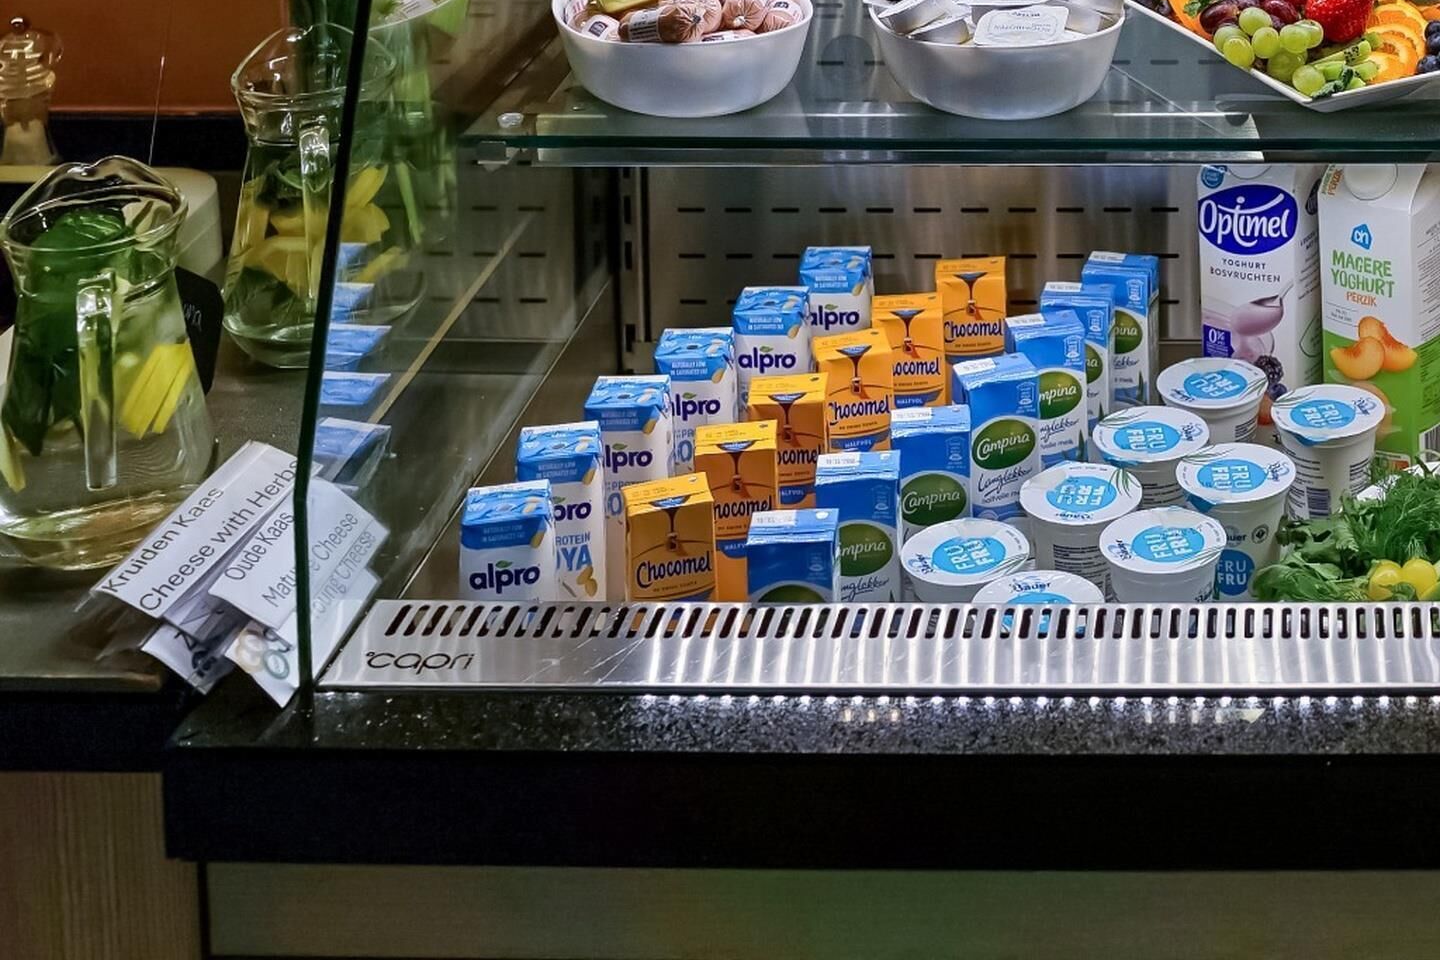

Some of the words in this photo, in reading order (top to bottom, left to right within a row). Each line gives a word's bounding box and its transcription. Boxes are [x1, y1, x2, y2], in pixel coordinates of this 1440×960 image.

[1200, 193, 1290, 248] Optimel
[1210, 266, 1281, 283] BOSVRUCHTEN
[1222, 258, 1267, 271] YOGHURT
[1332, 249, 1392, 278] MAGERE
[1330, 268, 1395, 298] YOGHURT
[1346, 291, 1377, 307] PERZIK
[944, 318, 1004, 344] Chocomel
[738, 347, 797, 374] alpro
[893, 355, 942, 376] ocomel
[672, 394, 721, 421] lpro
[1039, 383, 1077, 406] mpina
[976, 431, 1030, 461] Campina
[1127, 429, 1148, 450] FRU
[1145, 427, 1166, 449] FRU
[604, 444, 653, 473] lpro
[1212, 466, 1233, 491] FRU
[1230, 465, 1252, 489] FRU
[902, 488, 961, 515] Campina
[101, 528, 180, 593] Kruiden
[172, 487, 224, 528] Kaas
[224, 543, 268, 581] Oude
[255, 511, 295, 547] Kaas
[311, 512, 359, 561] Cheese
[555, 531, 591, 546] ROTEIN
[139, 544, 215, 611] Cheese
[210, 507, 257, 545] with
[840, 540, 887, 561] mpina
[944, 544, 975, 571] FRU
[311, 578, 348, 619] oung
[333, 530, 377, 580] Cheese
[469, 563, 541, 594] alpro
[636, 551, 713, 589] Chocomel
[1217, 560, 1247, 573] FRU
[1217, 573, 1247, 586] FRU
